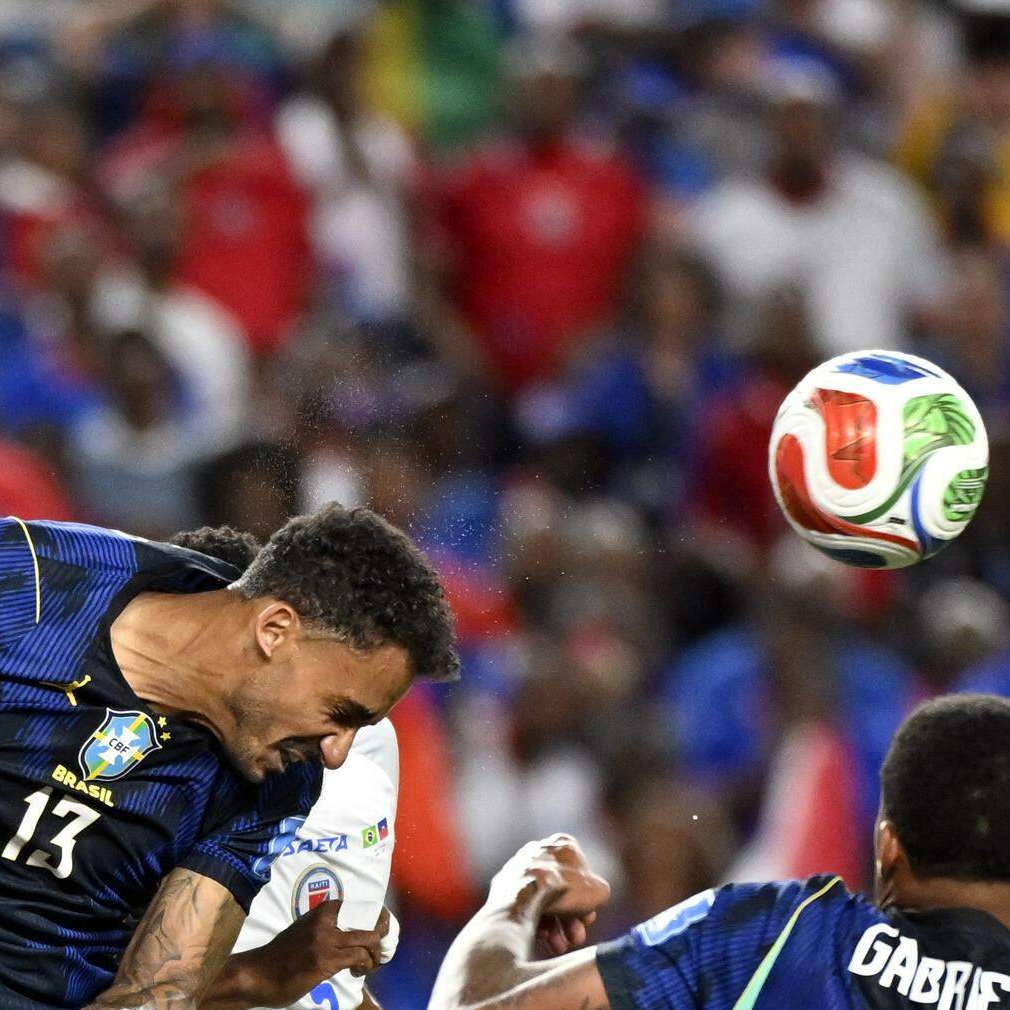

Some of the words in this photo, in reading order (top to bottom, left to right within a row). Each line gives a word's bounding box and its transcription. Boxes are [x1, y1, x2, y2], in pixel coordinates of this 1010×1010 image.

[108, 738, 129, 754] CBF
[51, 764, 115, 808] BRASIL
[1, 786, 102, 879] 13
[310, 880, 329, 890] HAITI
